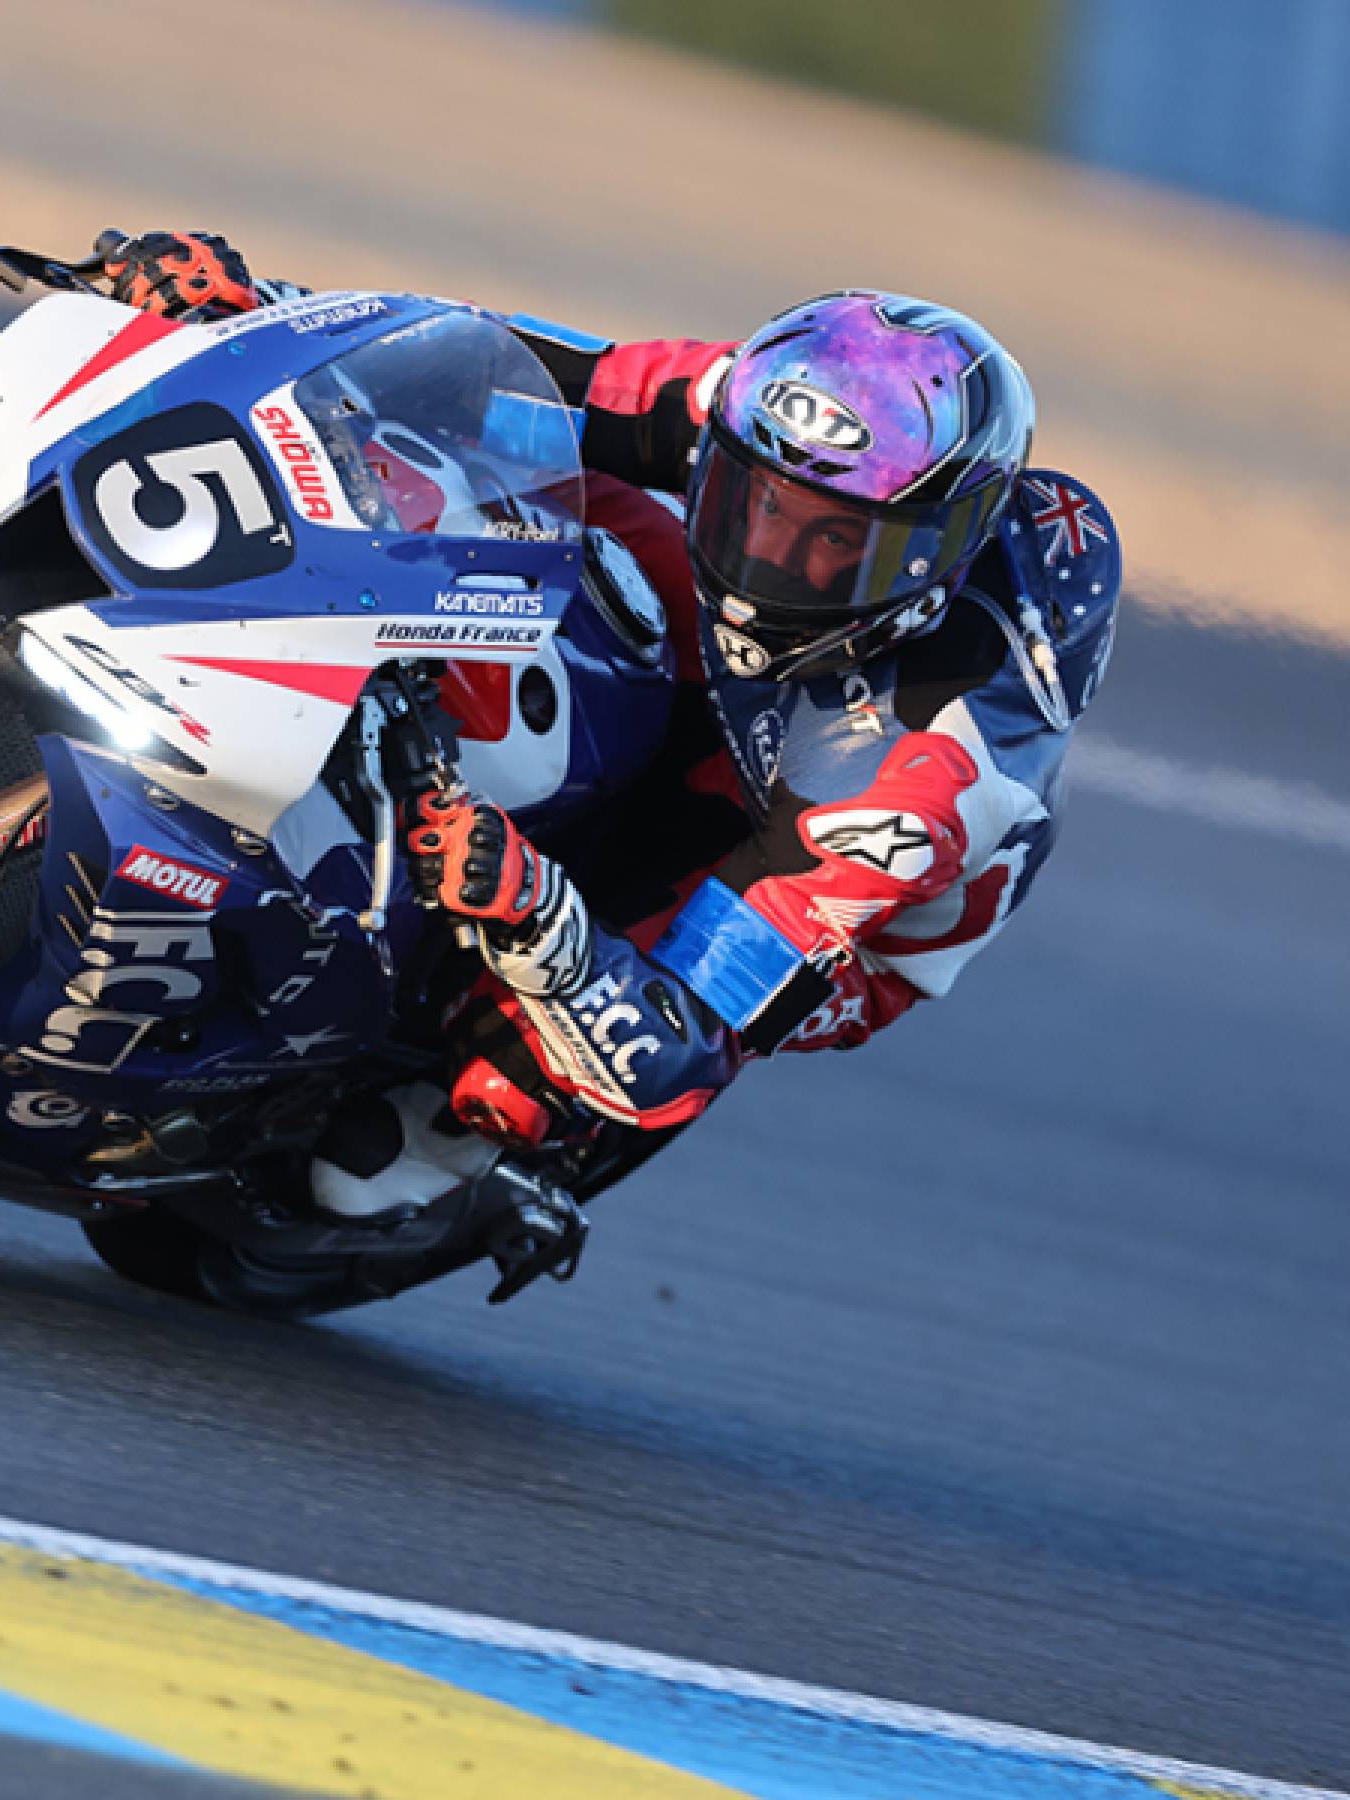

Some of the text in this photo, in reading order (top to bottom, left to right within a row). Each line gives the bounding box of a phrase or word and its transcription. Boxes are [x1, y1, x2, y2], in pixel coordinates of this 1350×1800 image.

[253, 406, 334, 519] SHOWA
[95, 438, 275, 571] 5
[376, 622, 542, 643] Honda France
[125, 854, 222, 906] MOTUL
